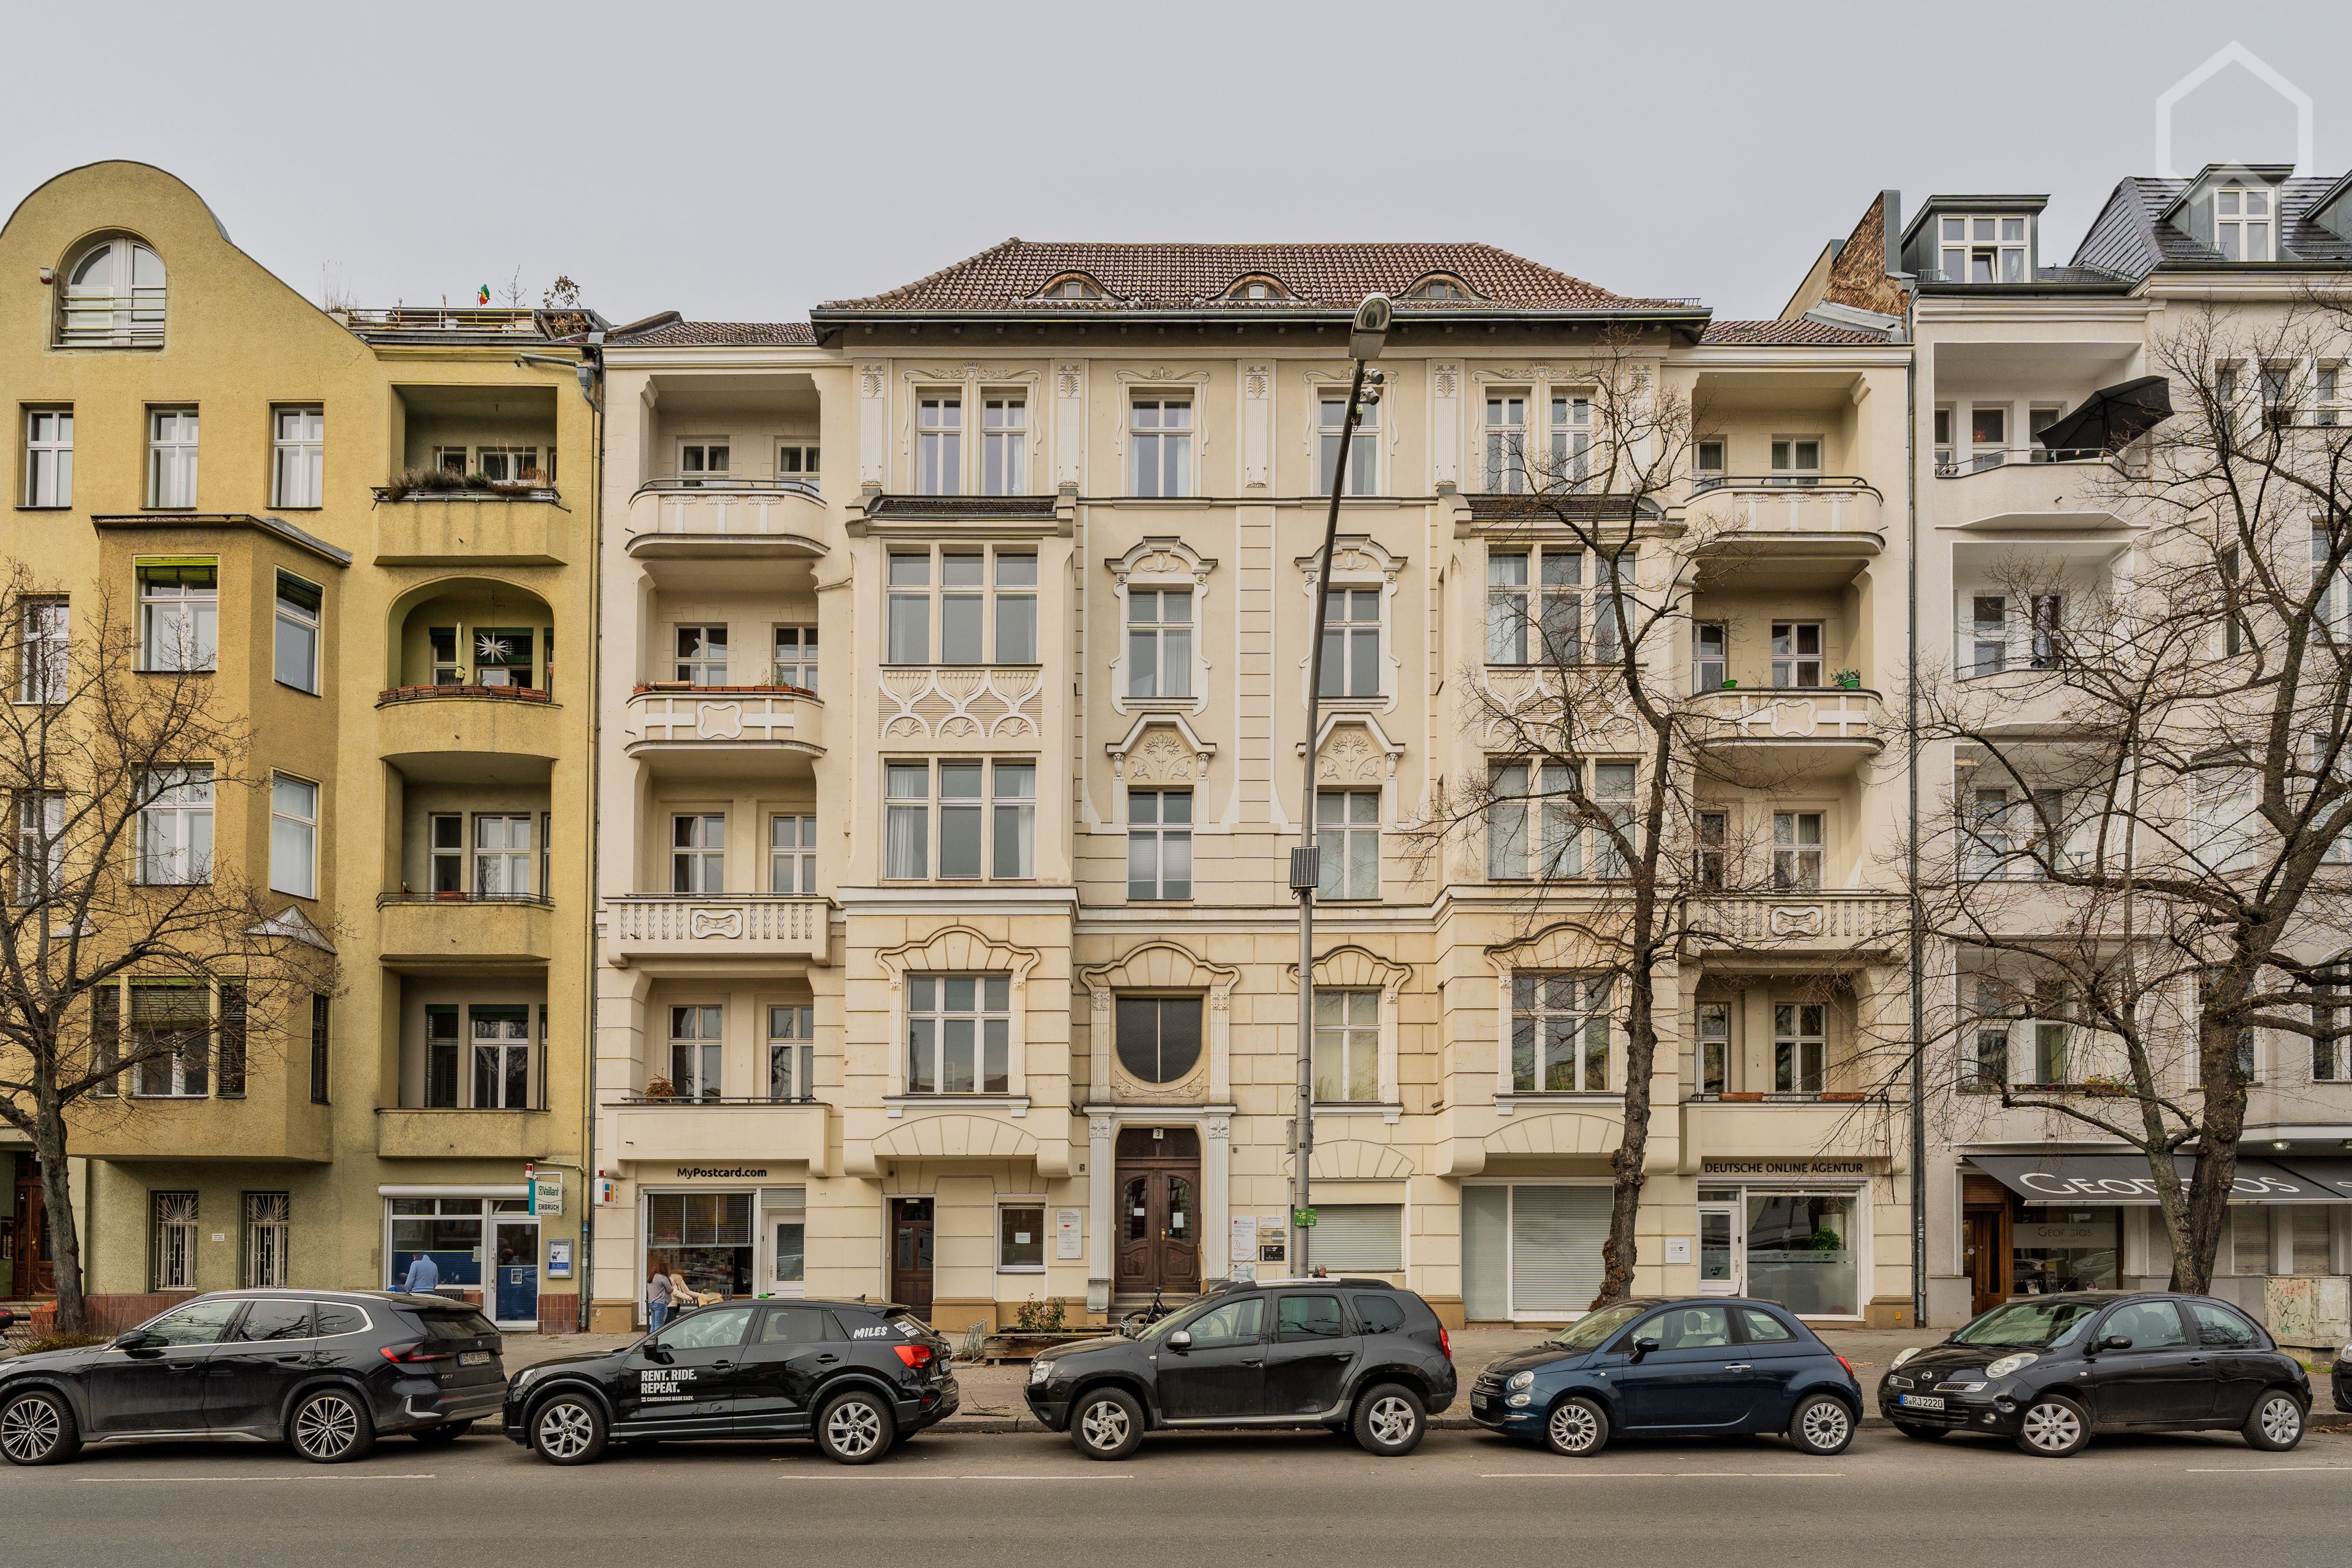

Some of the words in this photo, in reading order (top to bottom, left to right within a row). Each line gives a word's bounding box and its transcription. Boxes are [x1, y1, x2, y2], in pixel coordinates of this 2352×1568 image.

[677, 1167, 767, 1179] MyPostcard.com
[1705, 1163, 1763, 1173] DEUTSCHE
[1766, 1163, 1808, 1173] ONLINE
[1810, 1163, 1863, 1173] AGENTUR
[542, 1186, 559, 1196] Vaillant
[853, 1326, 888, 1339] MILES
[462, 1354, 467, 1363] B
[469, 1353, 477, 1362] NR
[641, 1370, 669, 1382] RENT.
[671, 1369, 697, 1380] RIDE.
[641, 1382, 680, 1394] REPEAT.
[1903, 1396, 1908, 1405] B
[1912, 1397, 1922, 1406] RJ
[1923, 1398, 1943, 1408] 2220
